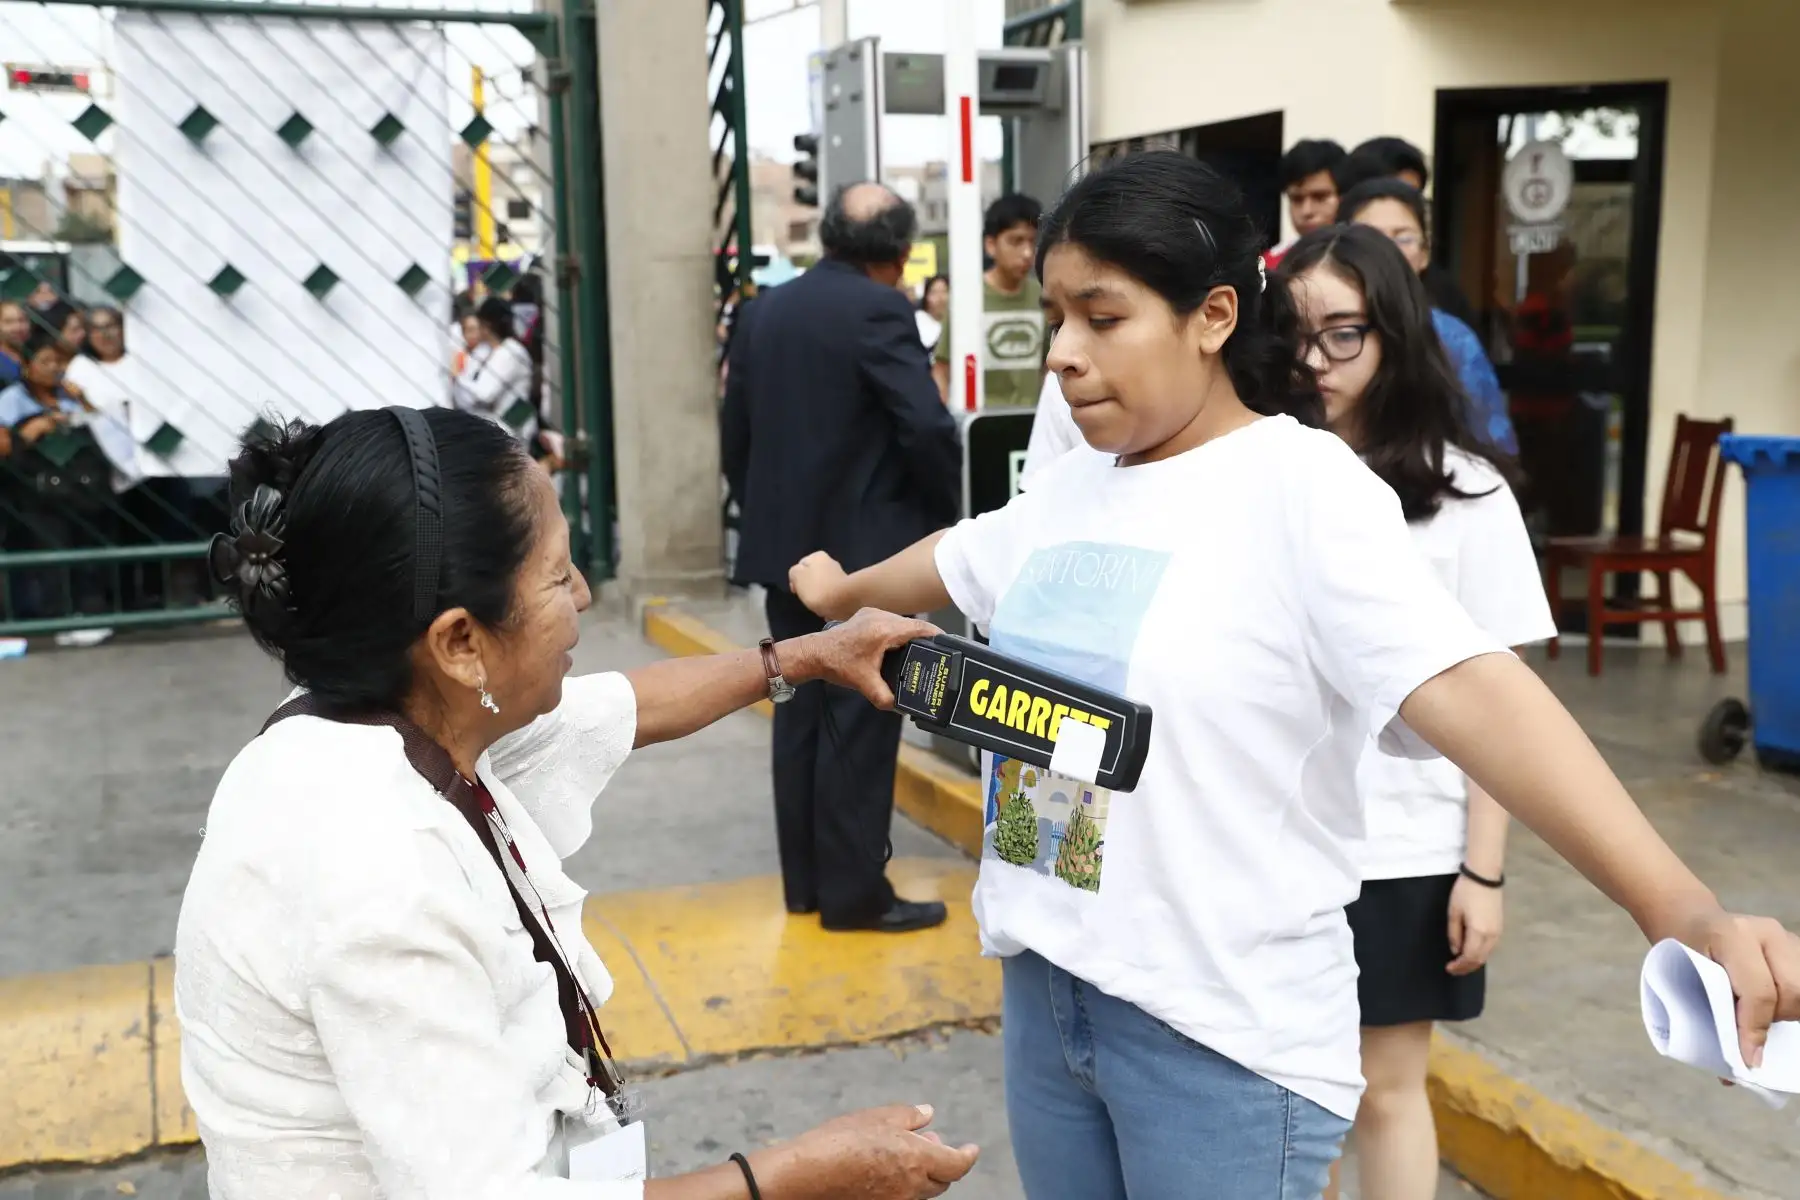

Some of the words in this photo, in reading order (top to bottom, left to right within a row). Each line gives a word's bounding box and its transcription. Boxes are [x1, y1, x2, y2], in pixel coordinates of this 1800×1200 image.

[910, 661, 921, 694] GARRETT
[931, 656, 946, 706] SCANNER
[936, 667, 949, 706] SUPER
